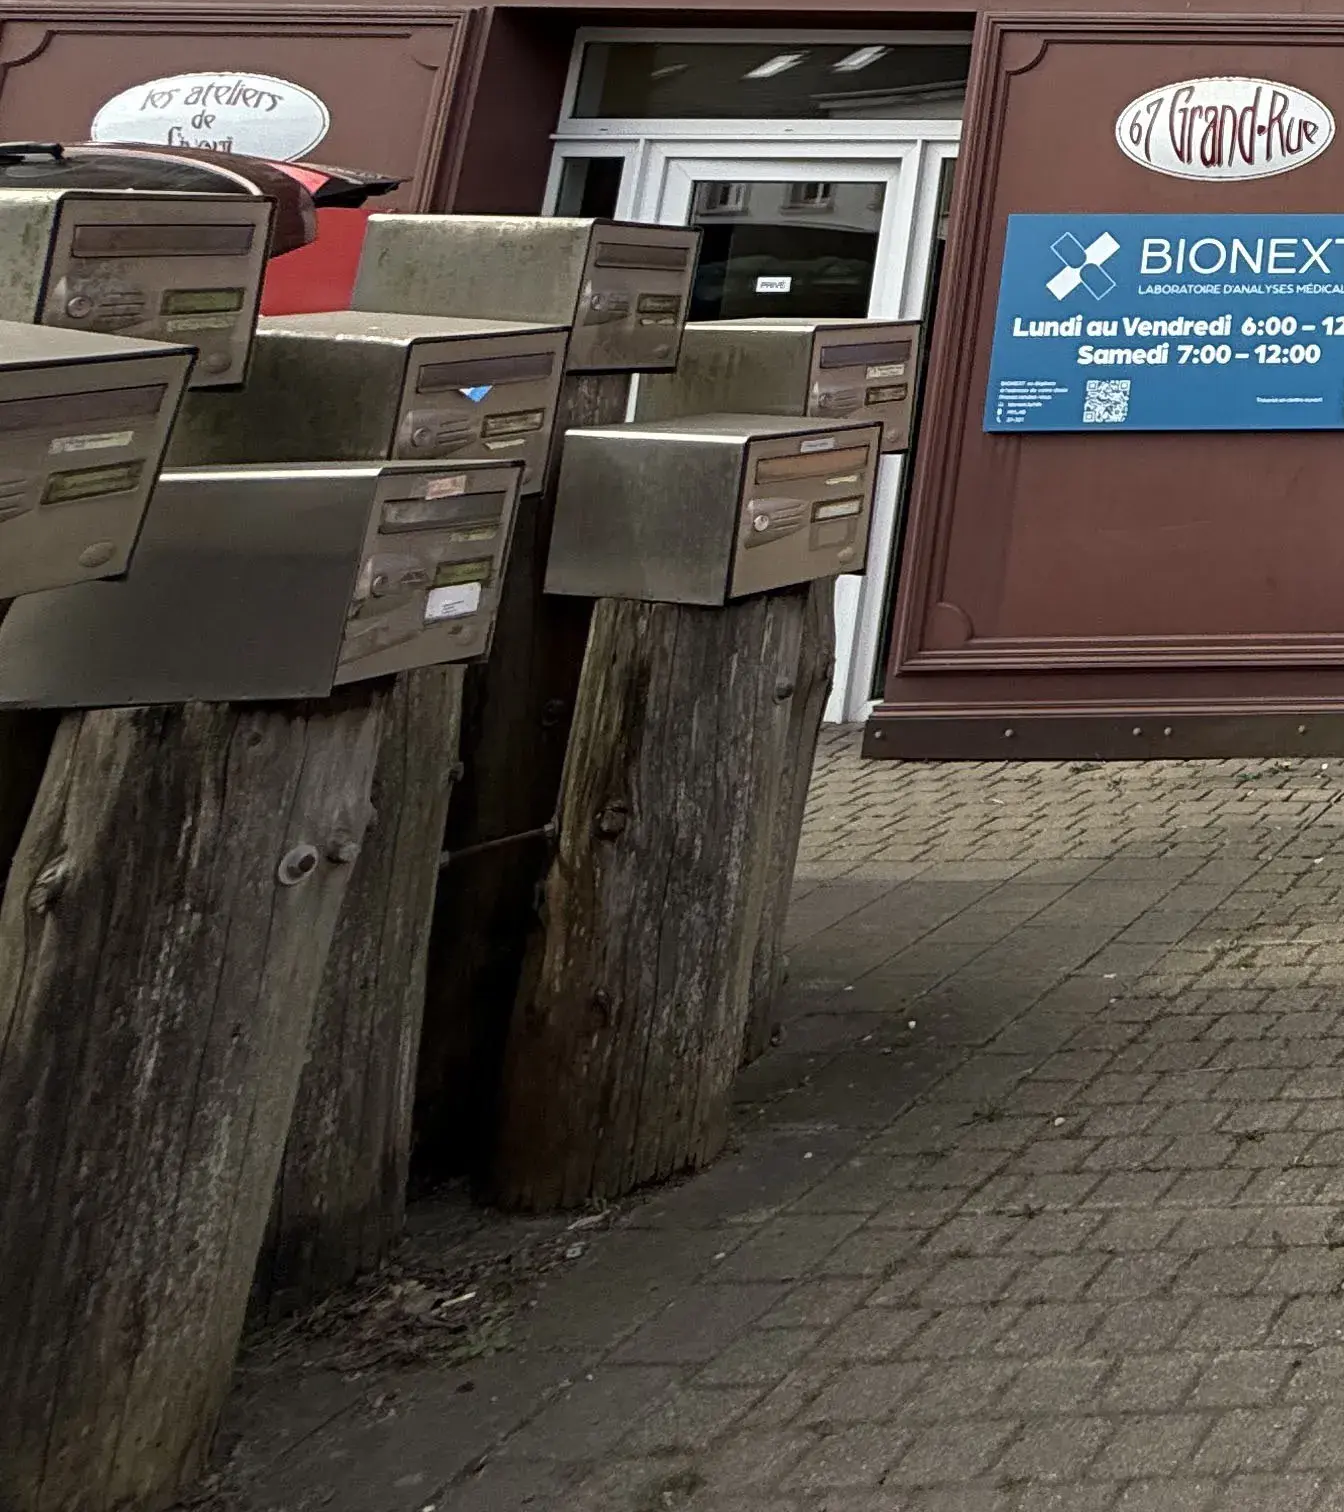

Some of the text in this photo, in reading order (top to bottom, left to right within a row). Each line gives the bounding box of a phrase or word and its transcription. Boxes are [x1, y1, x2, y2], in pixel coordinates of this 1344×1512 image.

[139, 79, 284, 112] les ateliers
[191, 108, 216, 129] de
[1129, 97, 1165, 163] 67
[1138, 283, 1222, 295] LABORATOIRE
[1013, 314, 1082, 337] Lundi
[1087, 321, 1118, 337] au
[1123, 314, 1232, 337] Vendredi
[1241, 316, 1298, 337] 6:00
[1077, 342, 1168, 365] Samedi
[1177, 344, 1232, 365] 7:00
[1254, 344, 1321, 365] 12:00
